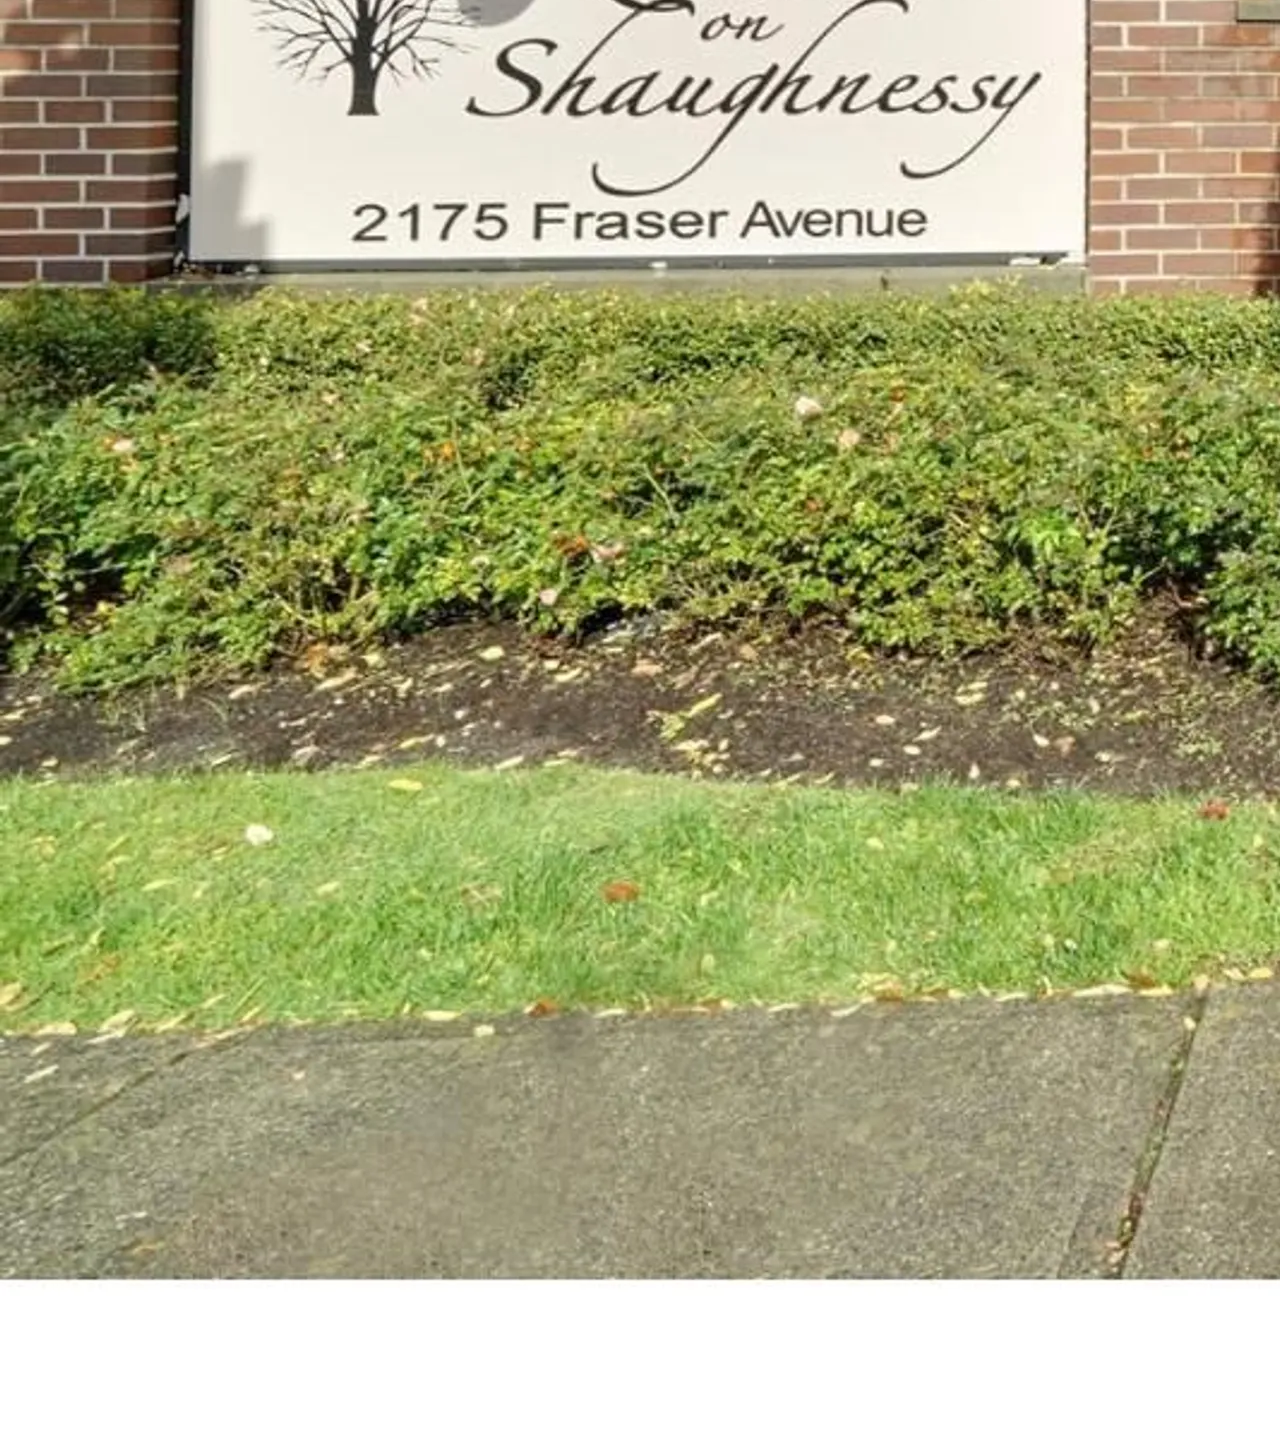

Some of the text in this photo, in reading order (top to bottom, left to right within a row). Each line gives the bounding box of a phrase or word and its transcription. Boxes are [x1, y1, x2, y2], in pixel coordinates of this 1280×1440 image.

[700, 9, 783, 44] on
[352, 201, 928, 242] 2175 Fraser Avenue
